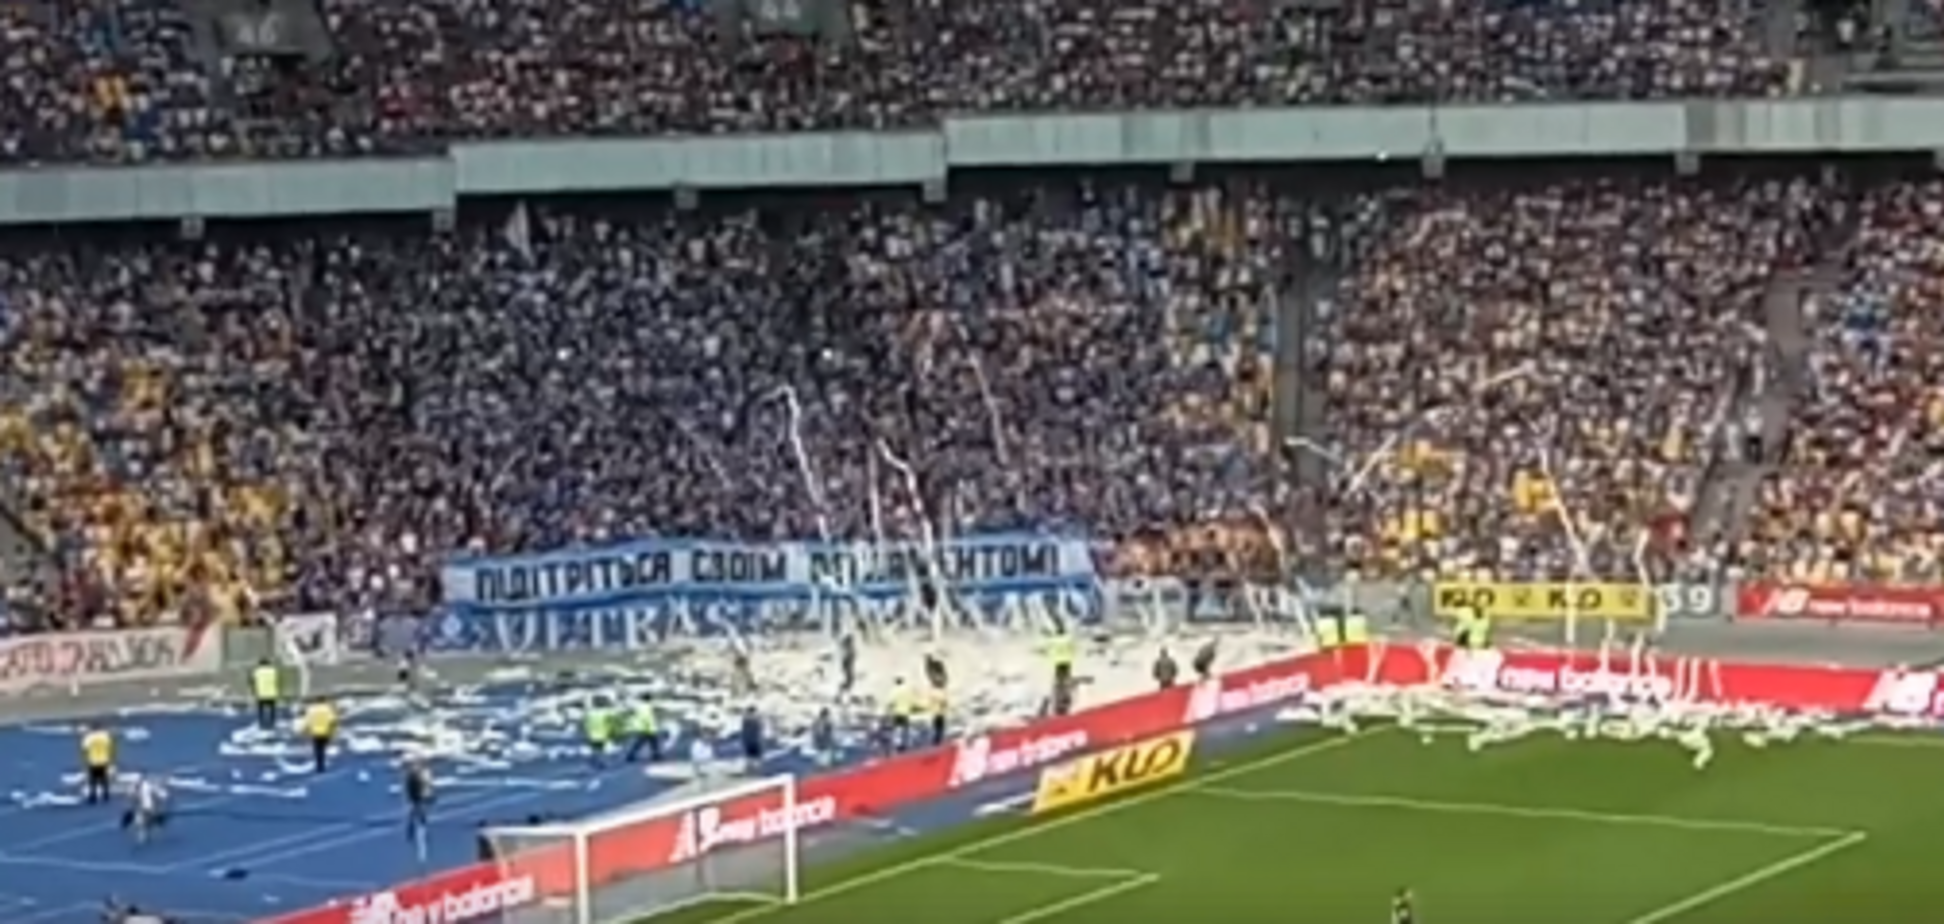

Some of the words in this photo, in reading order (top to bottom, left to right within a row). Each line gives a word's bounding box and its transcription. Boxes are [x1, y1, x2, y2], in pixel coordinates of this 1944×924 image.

[1549, 587, 1602, 610] KO
[1087, 738, 1181, 793] KLO
[758, 795, 837, 837] baance
